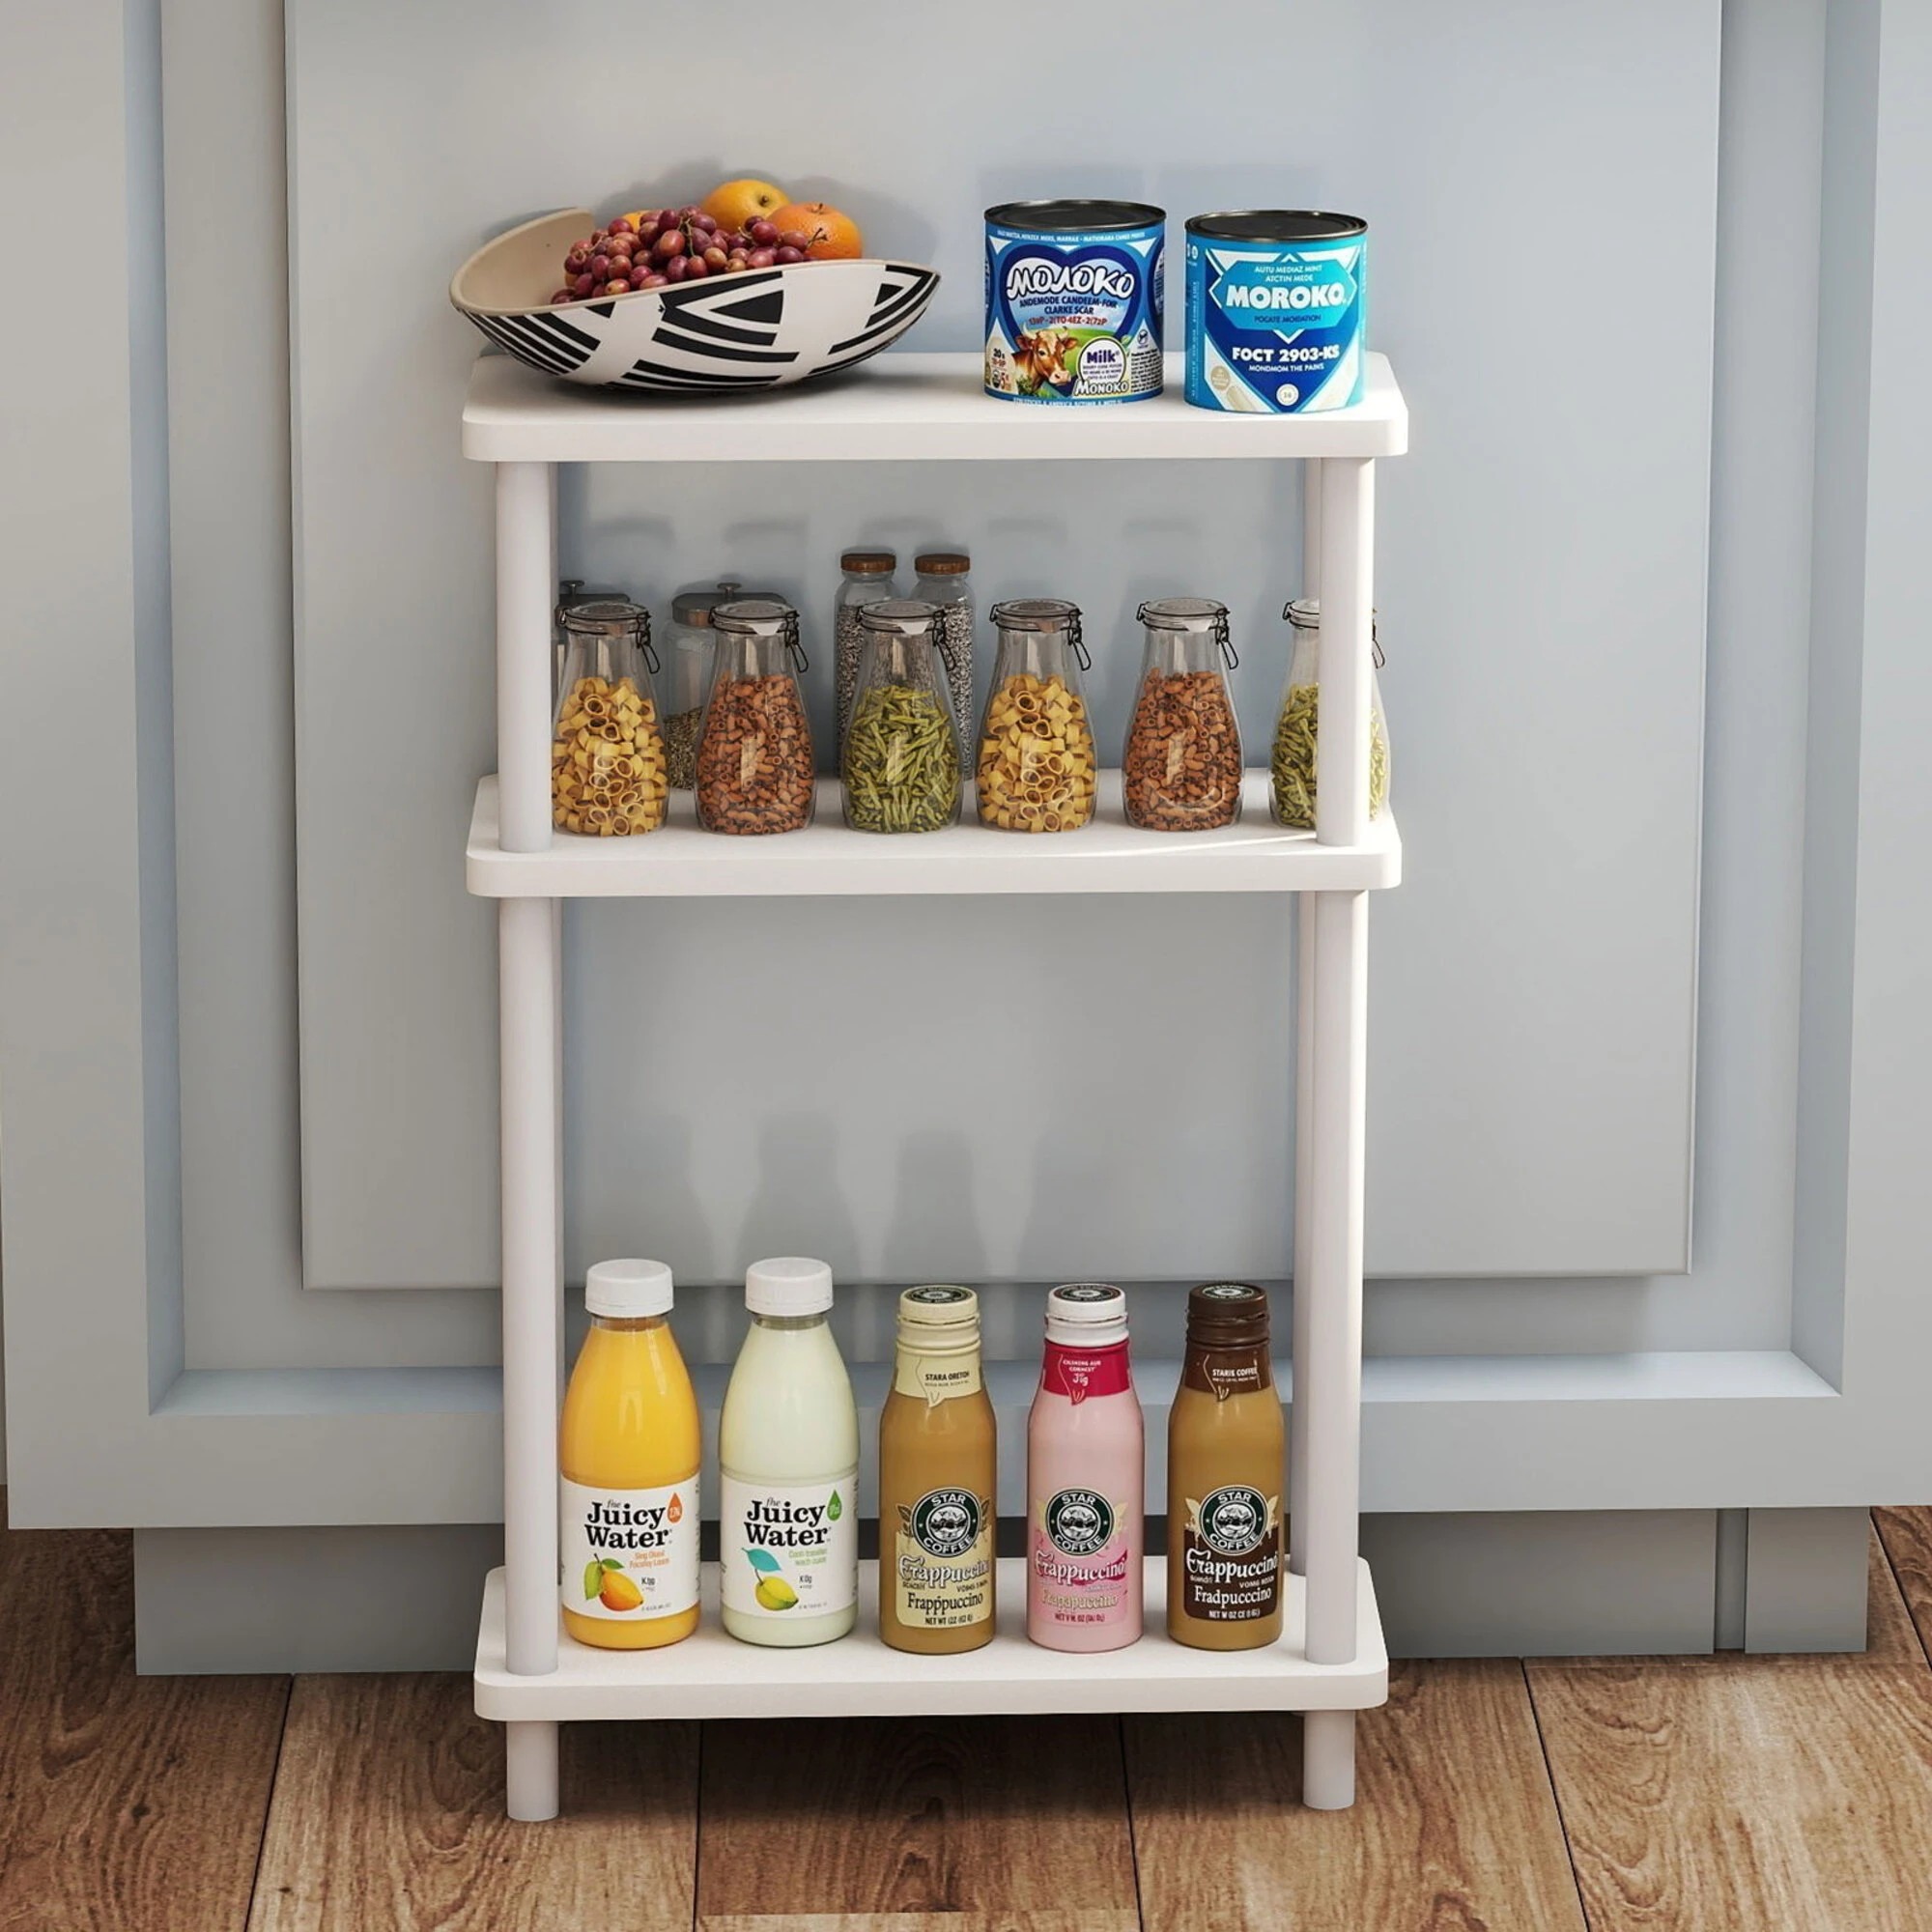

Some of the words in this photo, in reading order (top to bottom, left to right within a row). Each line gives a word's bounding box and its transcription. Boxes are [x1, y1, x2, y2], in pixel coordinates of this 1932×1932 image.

[1226, 282, 1345, 309] MOROKO
[1087, 349, 1116, 364] Milk
[1232, 347, 1274, 362] FOCT
[931, 1493, 966, 1507] STAR
[1062, 1493, 1096, 1506] STAR
[1218, 1492, 1252, 1504] STAR
[587, 1501, 666, 1530] Juicy
[747, 1499, 826, 1527] Juicy
[584, 1523, 668, 1549] Water
[744, 1521, 828, 1547] Water
[1209, 1532, 1260, 1550] COFFEE
[923, 1535, 973, 1553] COFFEE
[1055, 1535, 1103, 1552] COFFEE
